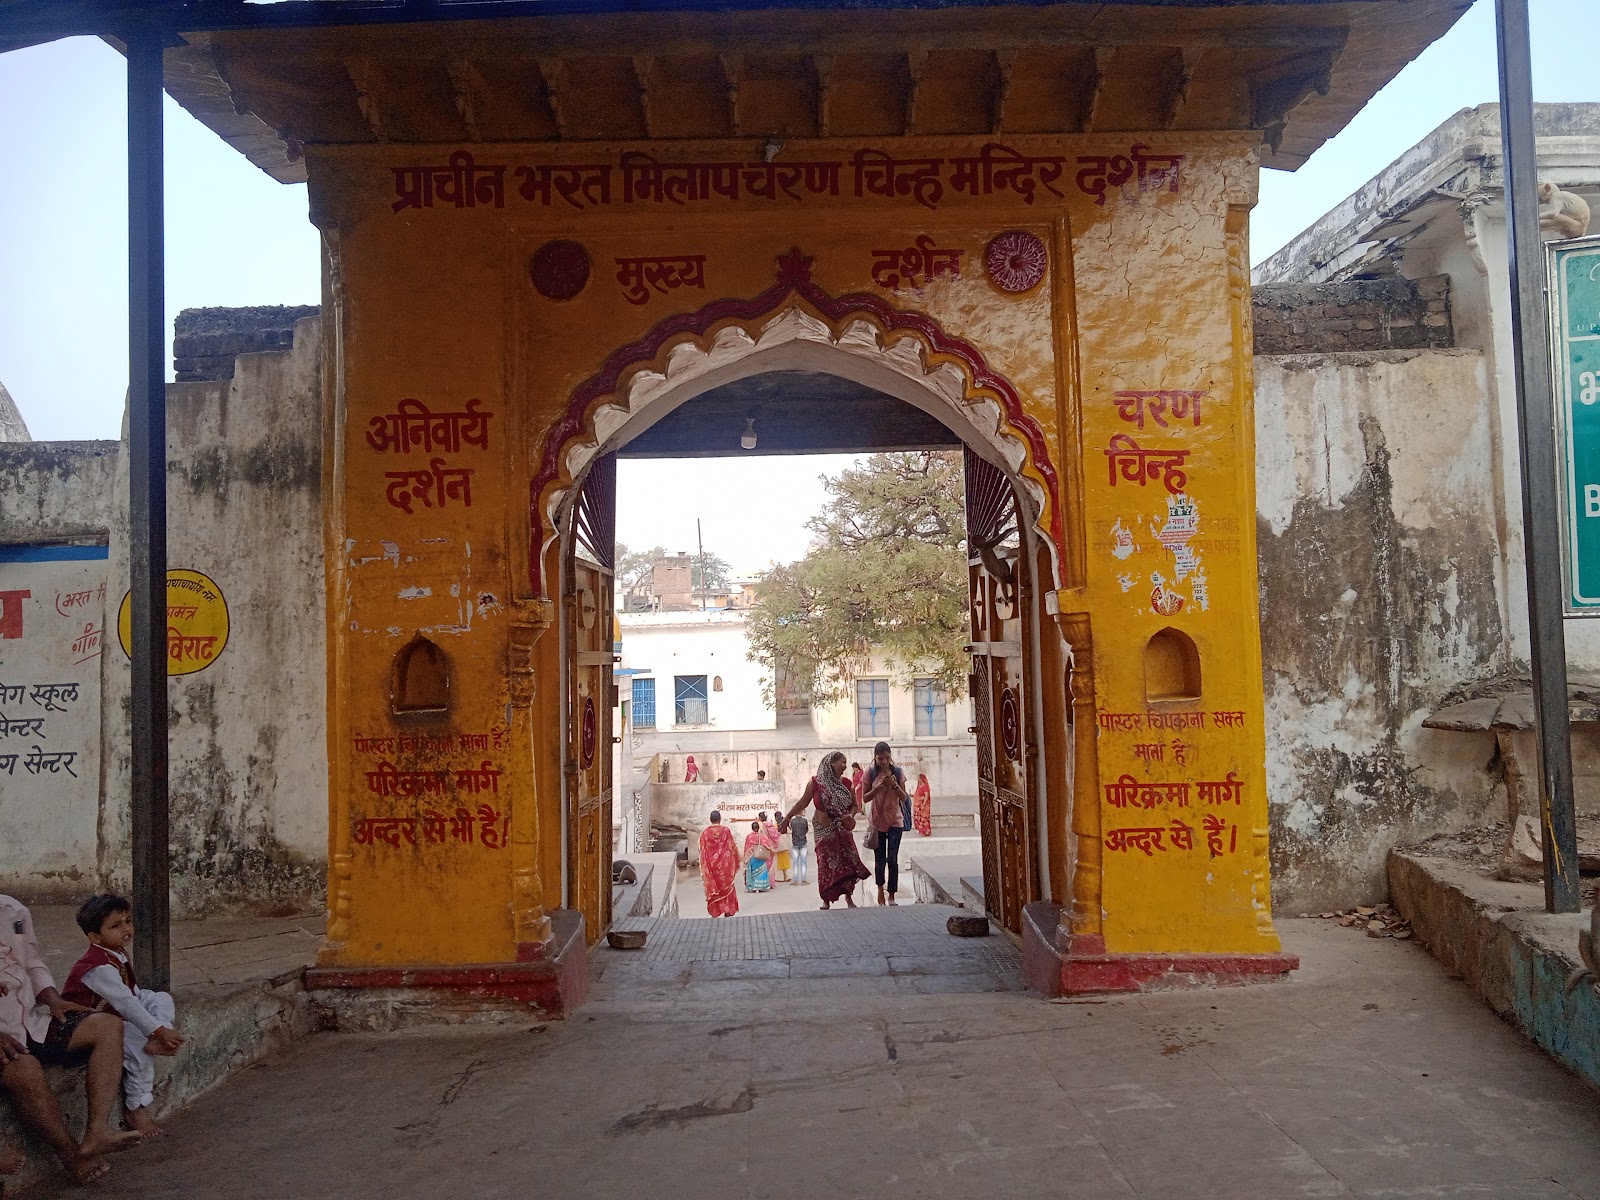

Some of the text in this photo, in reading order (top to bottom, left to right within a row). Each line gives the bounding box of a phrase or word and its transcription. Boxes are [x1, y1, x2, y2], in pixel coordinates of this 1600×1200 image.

[391, 143, 1185, 214] प्राचीन भरत मिलाप चरण चिन्ह मन्दिर दर्शन
[615, 254, 707, 305] मुख्य
[871, 235, 965, 294] दर्शन
[365, 398, 494, 454] अनिवार्य
[1113, 390, 1208, 430] चरण
[384, 457, 475, 514] दर्शन
[1104, 434, 1191, 495] चिन्ह
[30, 683, 80, 712] स्कूल
[24, 745, 78, 778] सेन्टर
[366, 760, 503, 798] परिक्रमा मार्ग
[1104, 772, 1245, 809] परिक्रमा मार्ग
[353, 817, 417, 849] अन्दर
[423, 809, 448, 843] से
[449, 807, 476, 843] भी
[1104, 827, 1167, 857] अन्दर
[1170, 819, 1194, 850] से
